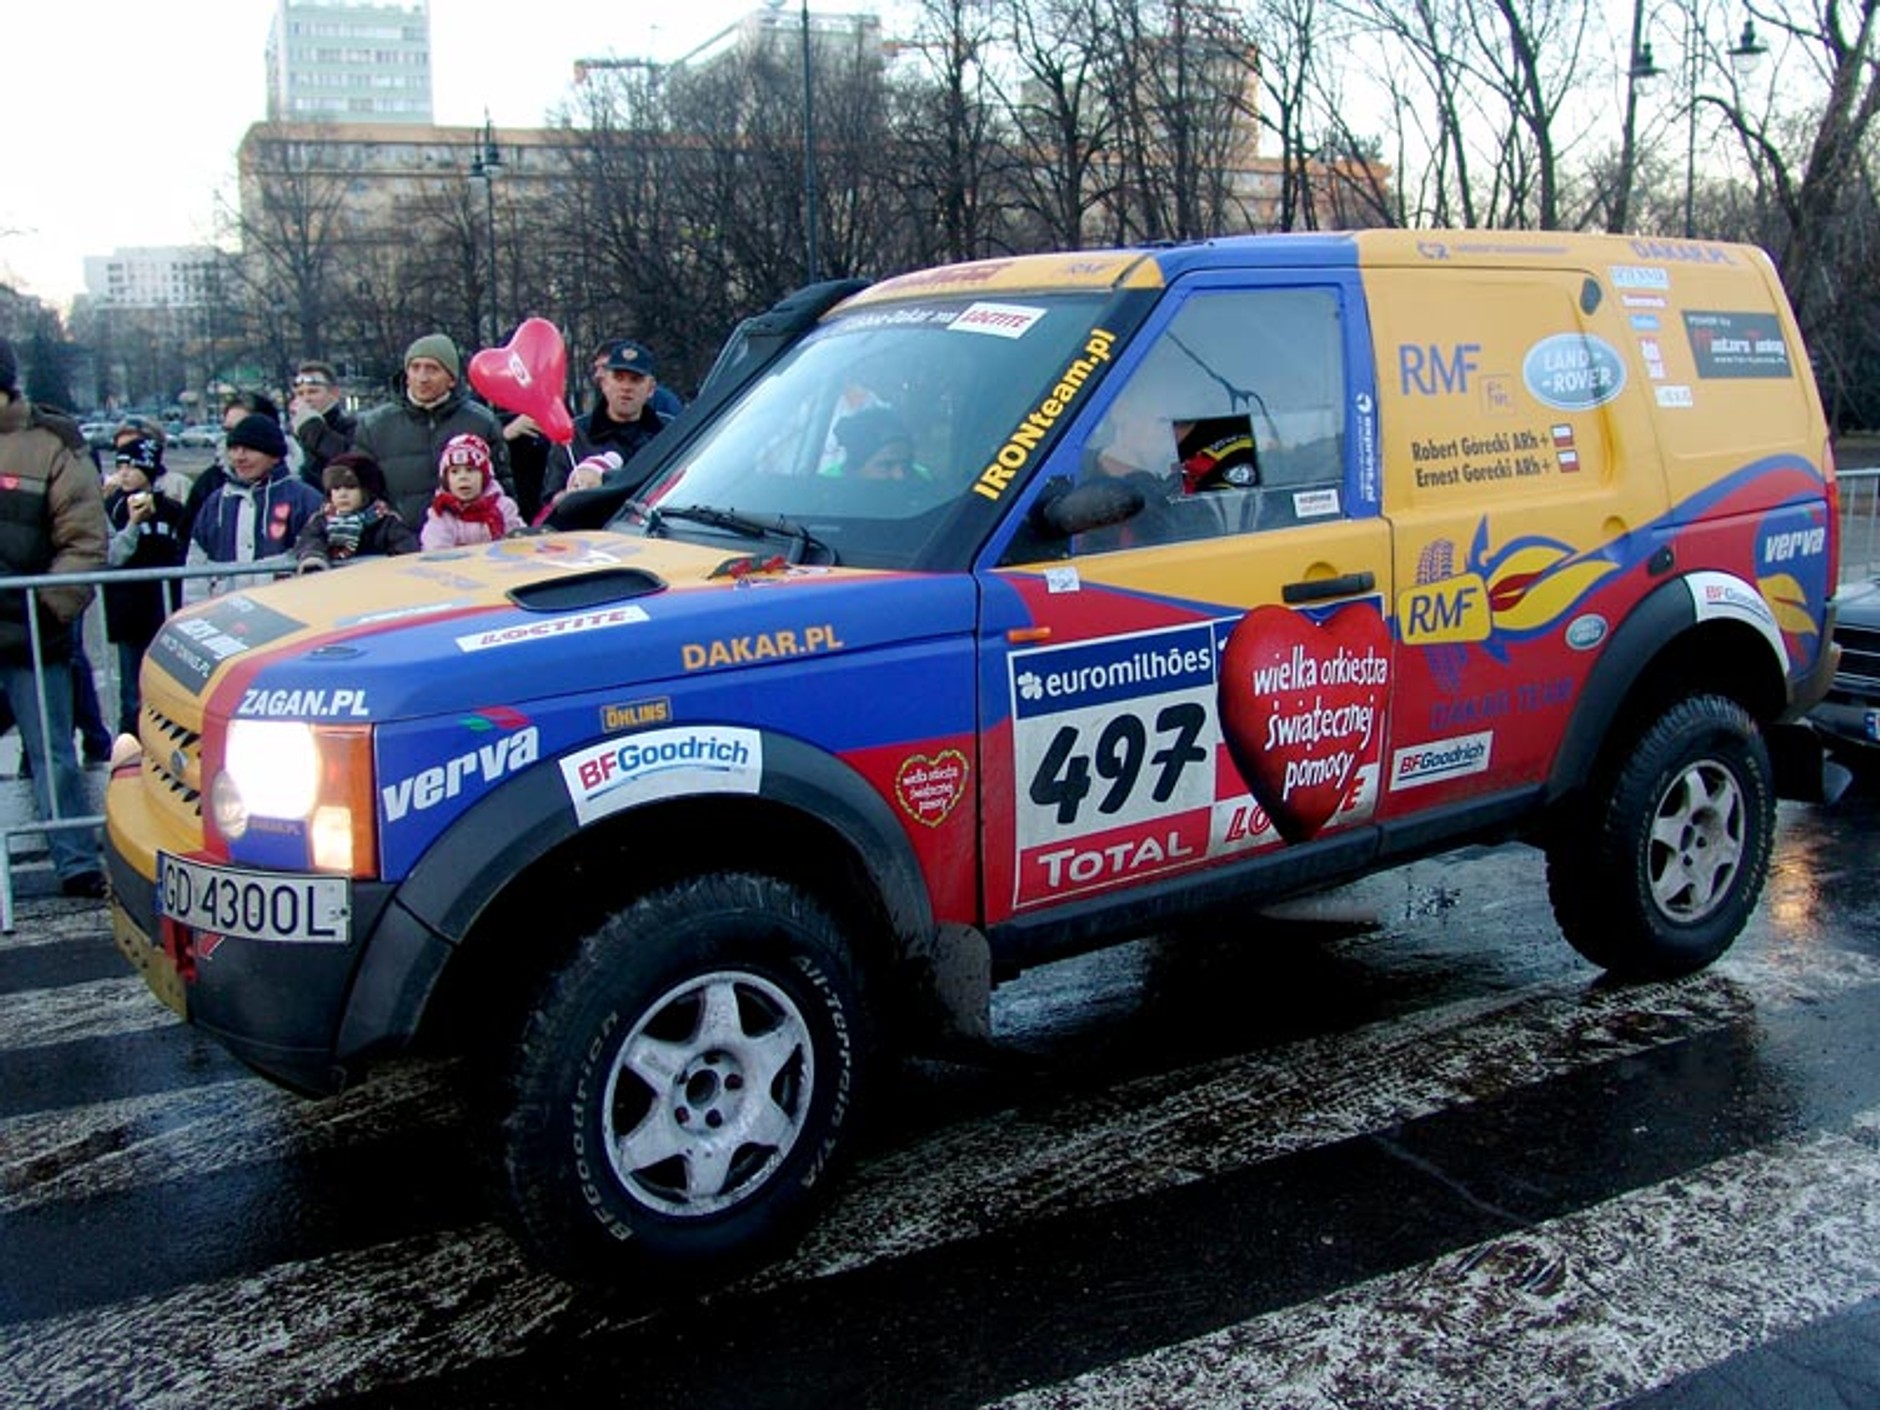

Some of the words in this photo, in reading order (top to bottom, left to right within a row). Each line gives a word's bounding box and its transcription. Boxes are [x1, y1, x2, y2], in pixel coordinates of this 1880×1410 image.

[1398, 344, 1481, 395] RMF
[1544, 348, 1590, 371] LAND
[1552, 367, 1613, 393] ROVER
[973, 328, 1116, 500] IRONteam.pl
[1412, 438, 1459, 462] Robert
[1462, 432, 1511, 458] Gorecki
[1415, 467, 1459, 488] Ernest
[1465, 458, 1513, 483] Gorecki
[1764, 527, 1825, 563] verva
[480, 609, 631, 647] LOCTITE
[1407, 587, 1477, 636] RMF
[681, 624, 844, 671] DAKAR.PL
[1254, 644, 1317, 696] wielka
[1320, 645, 1388, 686] orkiestra
[238, 689, 370, 716] ZAGAN.PL
[1264, 694, 1374, 751] świątecznej
[382, 727, 539, 823] verva
[578, 736, 749, 790] BFGoodrich
[1029, 702, 1207, 824] 497
[1283, 751, 1355, 801] pomocy
[1400, 741, 1485, 774] BFGoodrich
[1038, 831, 1193, 887] TOTAL
[164, 864, 192, 917] GD
[202, 876, 336, 938] 4300L
